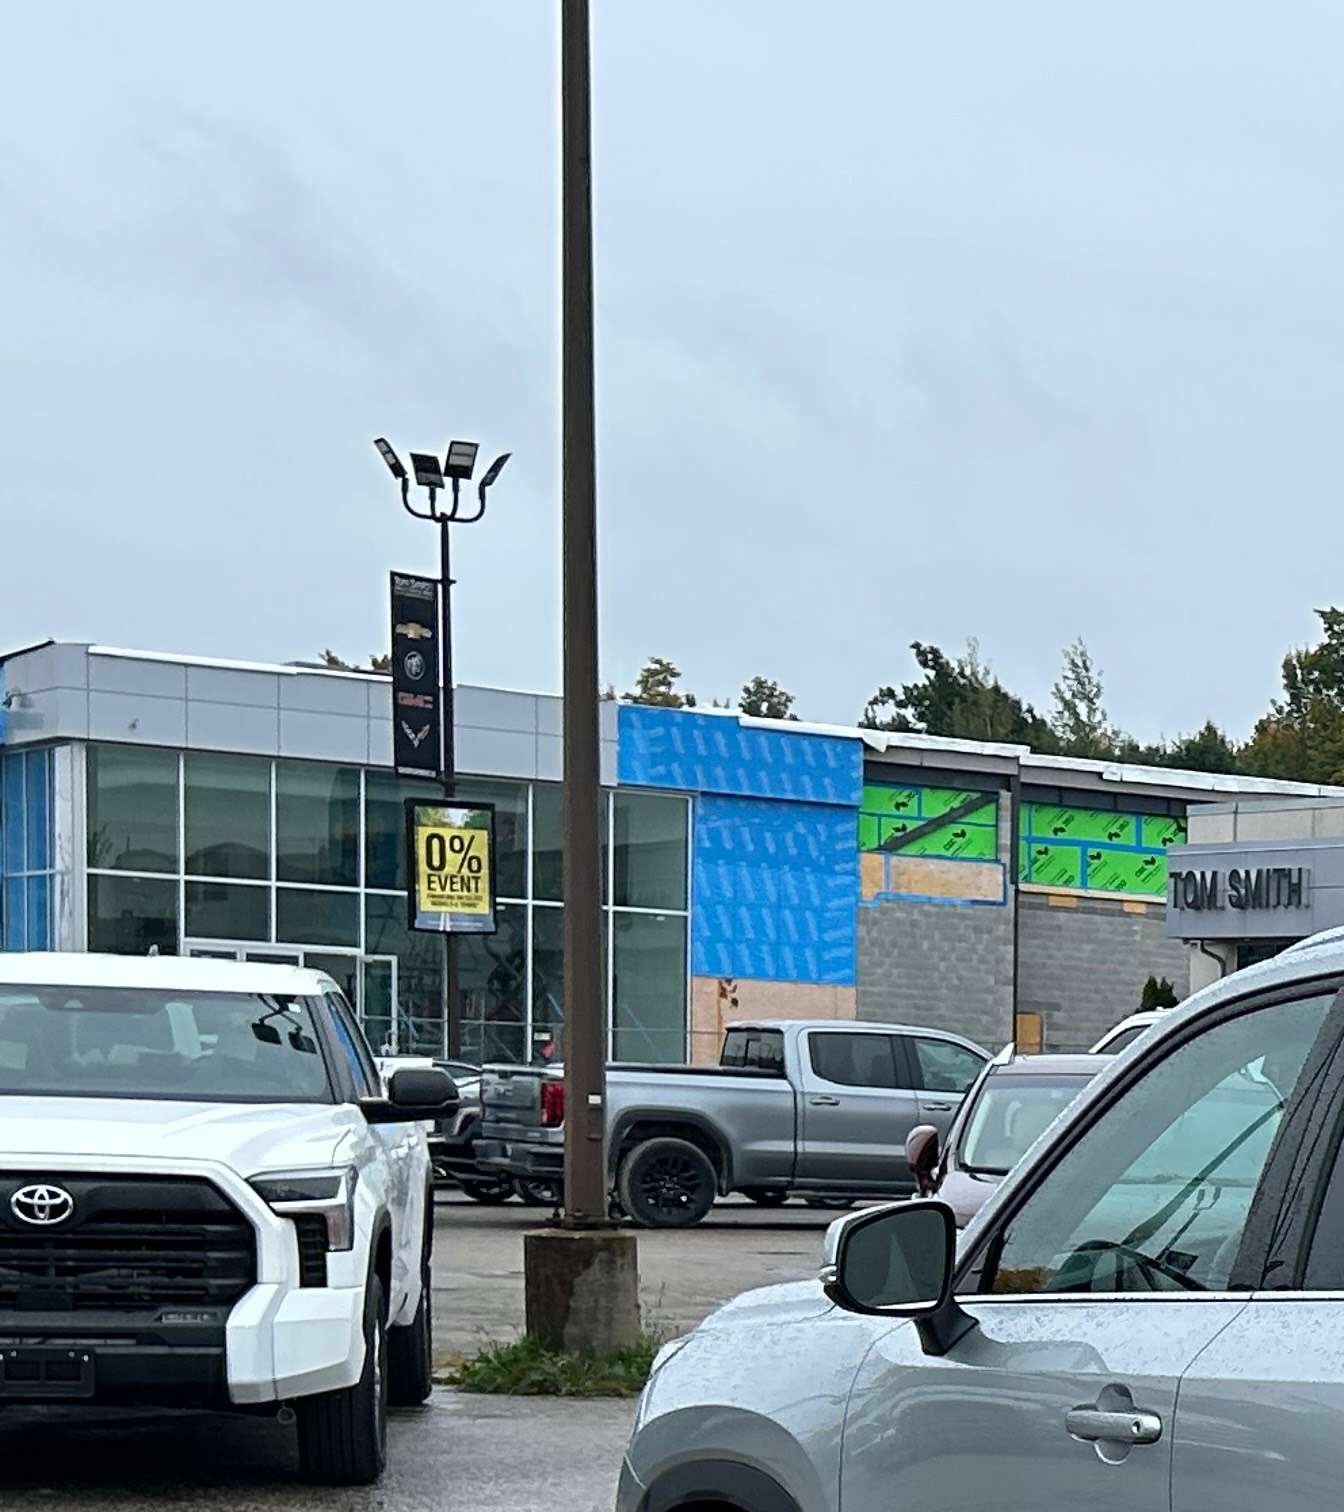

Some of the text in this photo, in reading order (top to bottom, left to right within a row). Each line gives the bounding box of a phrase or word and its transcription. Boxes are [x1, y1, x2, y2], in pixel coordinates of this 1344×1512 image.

[426, 833, 482, 873] 0%
[427, 874, 481, 893] EVENT
[1169, 868, 1307, 910] TOM SMITH
